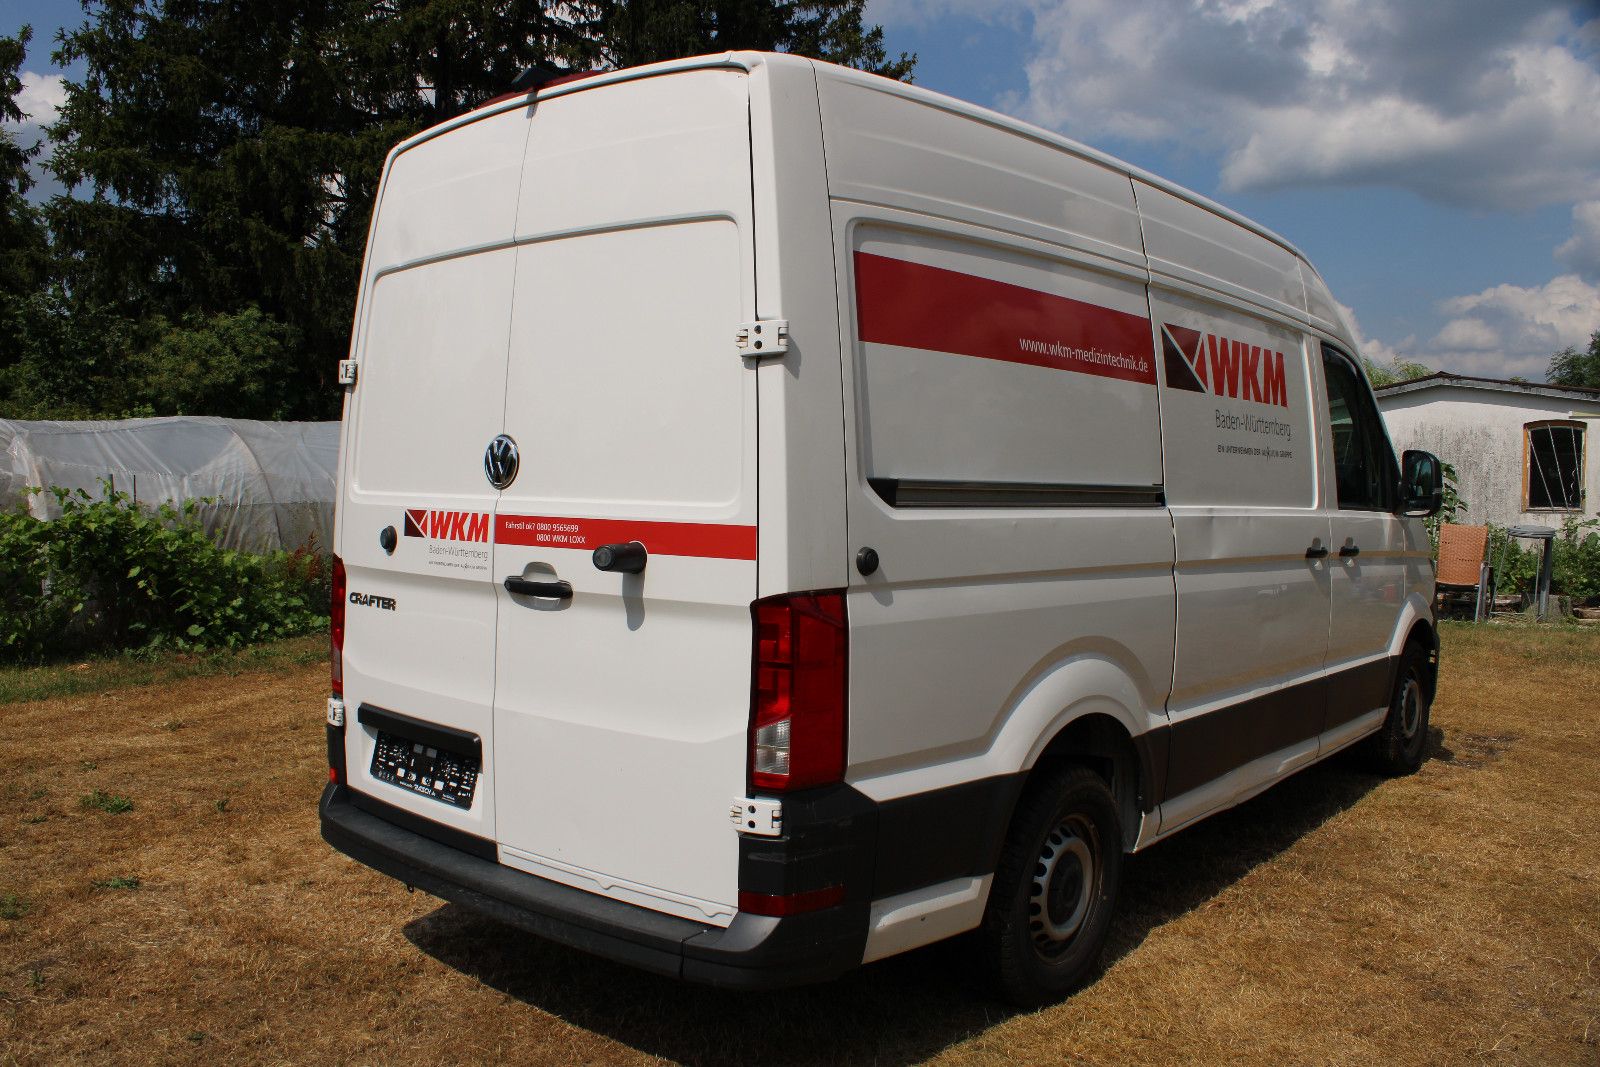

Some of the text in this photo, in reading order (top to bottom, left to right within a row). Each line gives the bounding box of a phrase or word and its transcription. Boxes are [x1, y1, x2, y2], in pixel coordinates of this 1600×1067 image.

[1019, 338, 1149, 373] www.wkm-medizintechnik.de
[1207, 333, 1288, 407] WKM
[1215, 408, 1292, 441] Baden-Württemberg
[430, 510, 490, 543] WKM
[536, 522, 552, 532] 0800
[552, 523, 579, 533] 9565699
[536, 533, 586, 544] 0800 WKM LOXX
[349, 592, 396, 611] CRAFTER
